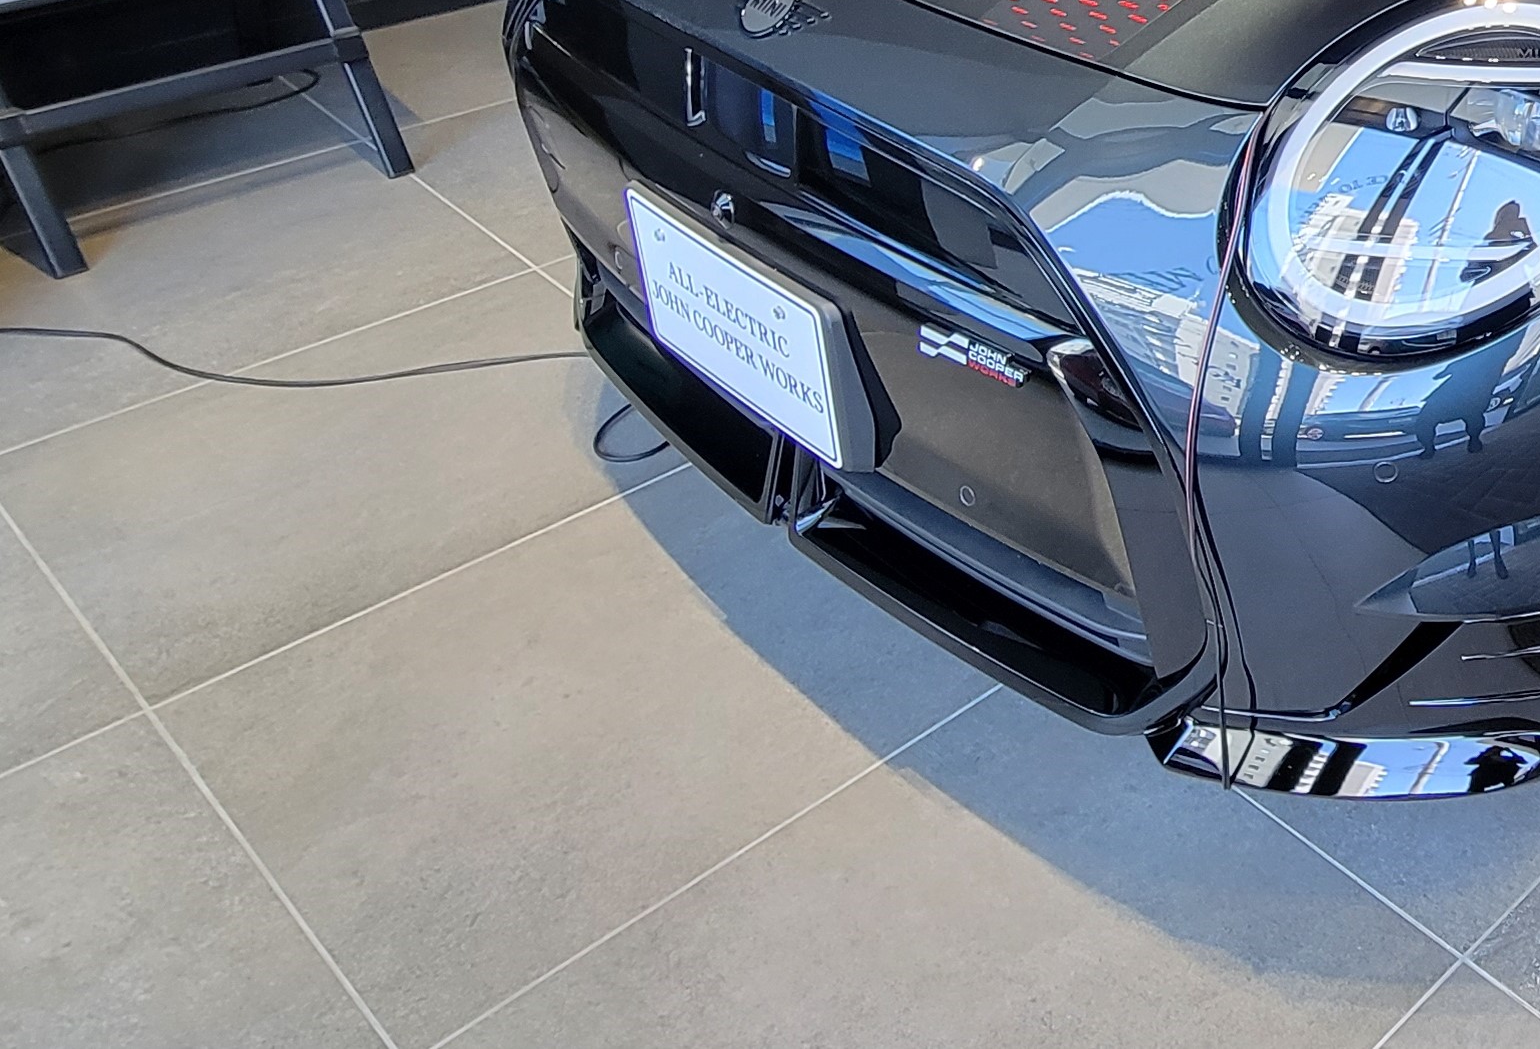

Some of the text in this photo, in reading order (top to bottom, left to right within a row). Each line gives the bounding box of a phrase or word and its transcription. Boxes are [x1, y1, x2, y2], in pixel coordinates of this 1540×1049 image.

[668, 261, 790, 358] ALL-ELECTRIC
[652, 279, 825, 415] JOHN COOPER WORKS
[969, 341, 1007, 365] JOHN
[967, 360, 1017, 388] WORKS
[968, 351, 1024, 383] COOPER
